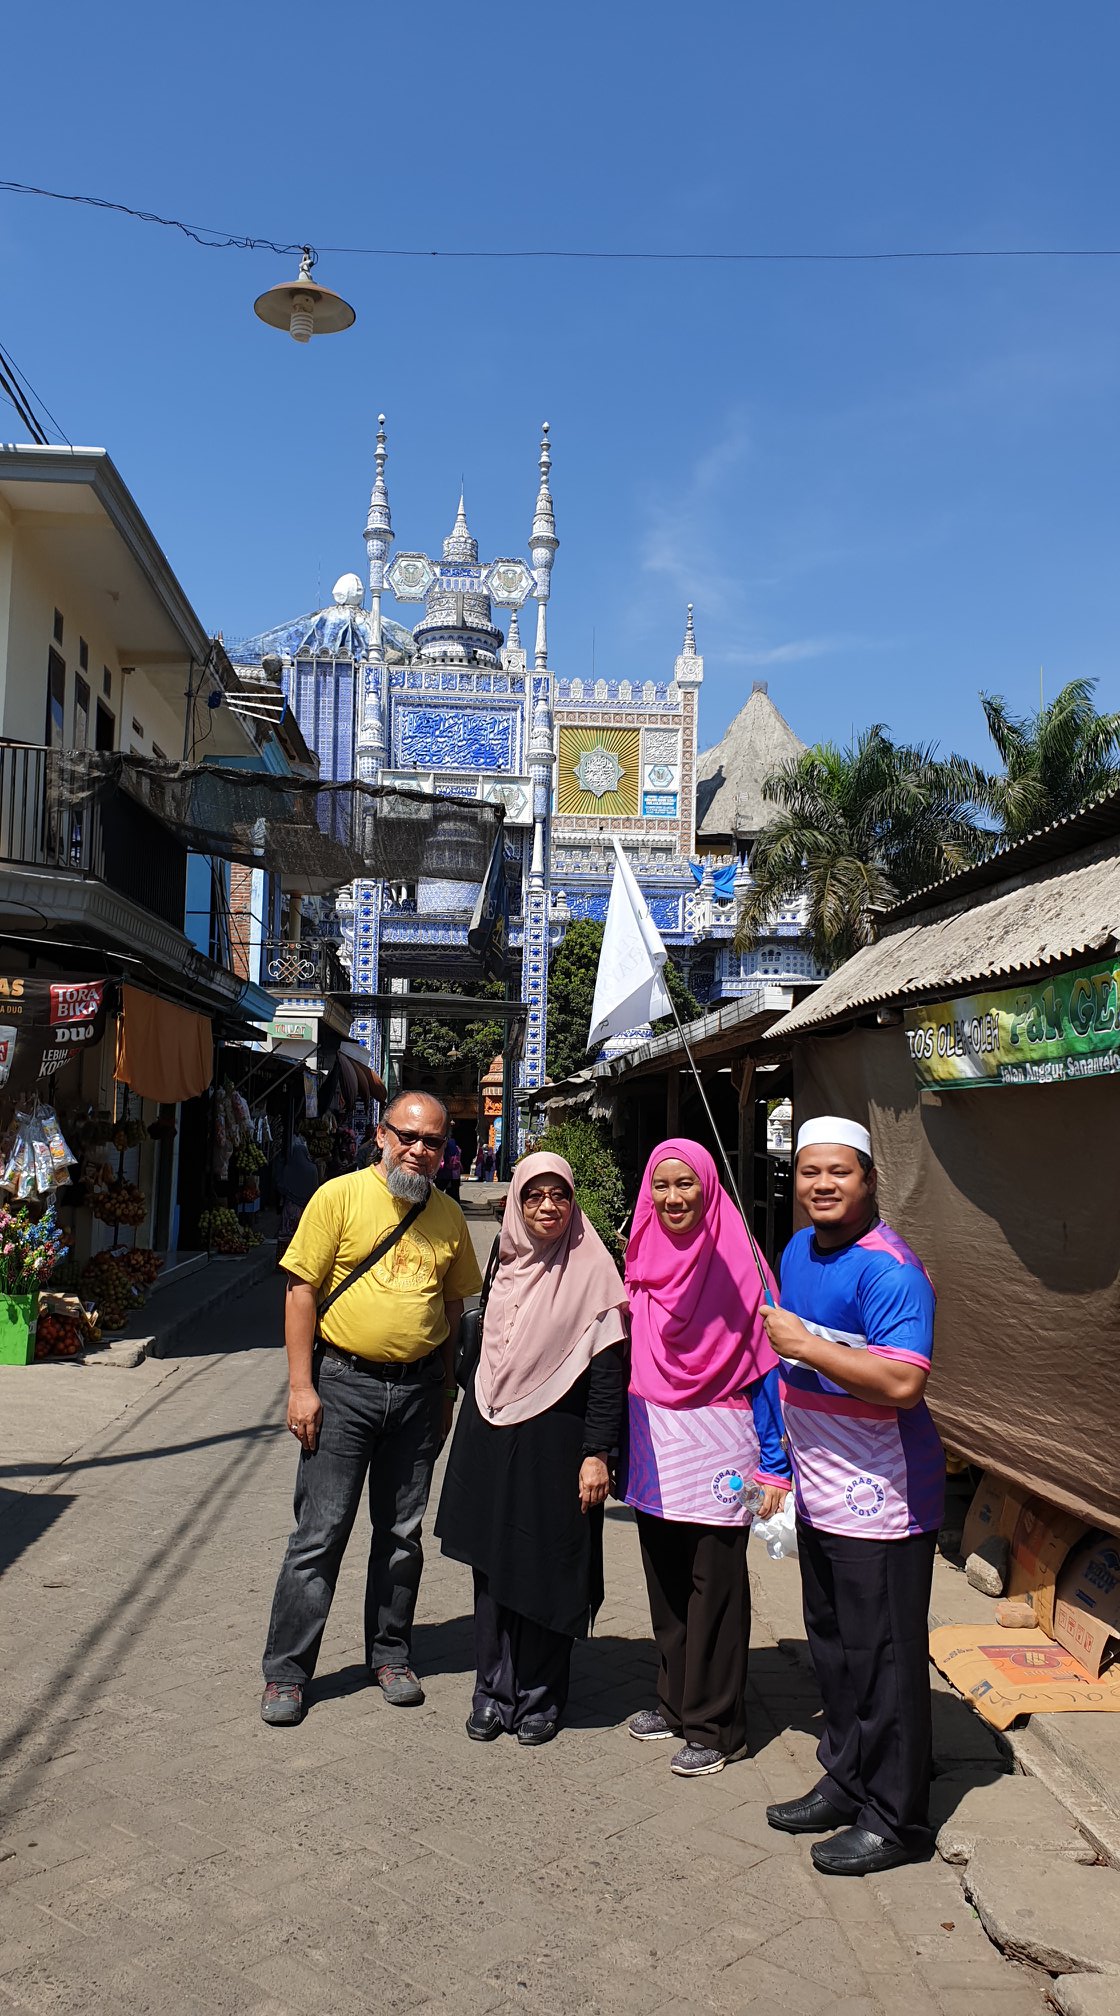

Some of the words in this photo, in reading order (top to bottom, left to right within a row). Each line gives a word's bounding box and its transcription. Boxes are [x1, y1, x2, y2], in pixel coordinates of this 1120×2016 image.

[54, 988, 100, 1002] TORA
[7, 1005, 23, 1014] DUO
[57, 1001, 99, 1017] BIKA
[55, 1024, 95, 1043] DUO
[42, 1049, 69, 1062] LEBIH
[1025, 1062, 1066, 1084] Anggur,
[845, 1476, 884, 1502] SURABAYA
[850, 1504, 879, 1517] 2018
